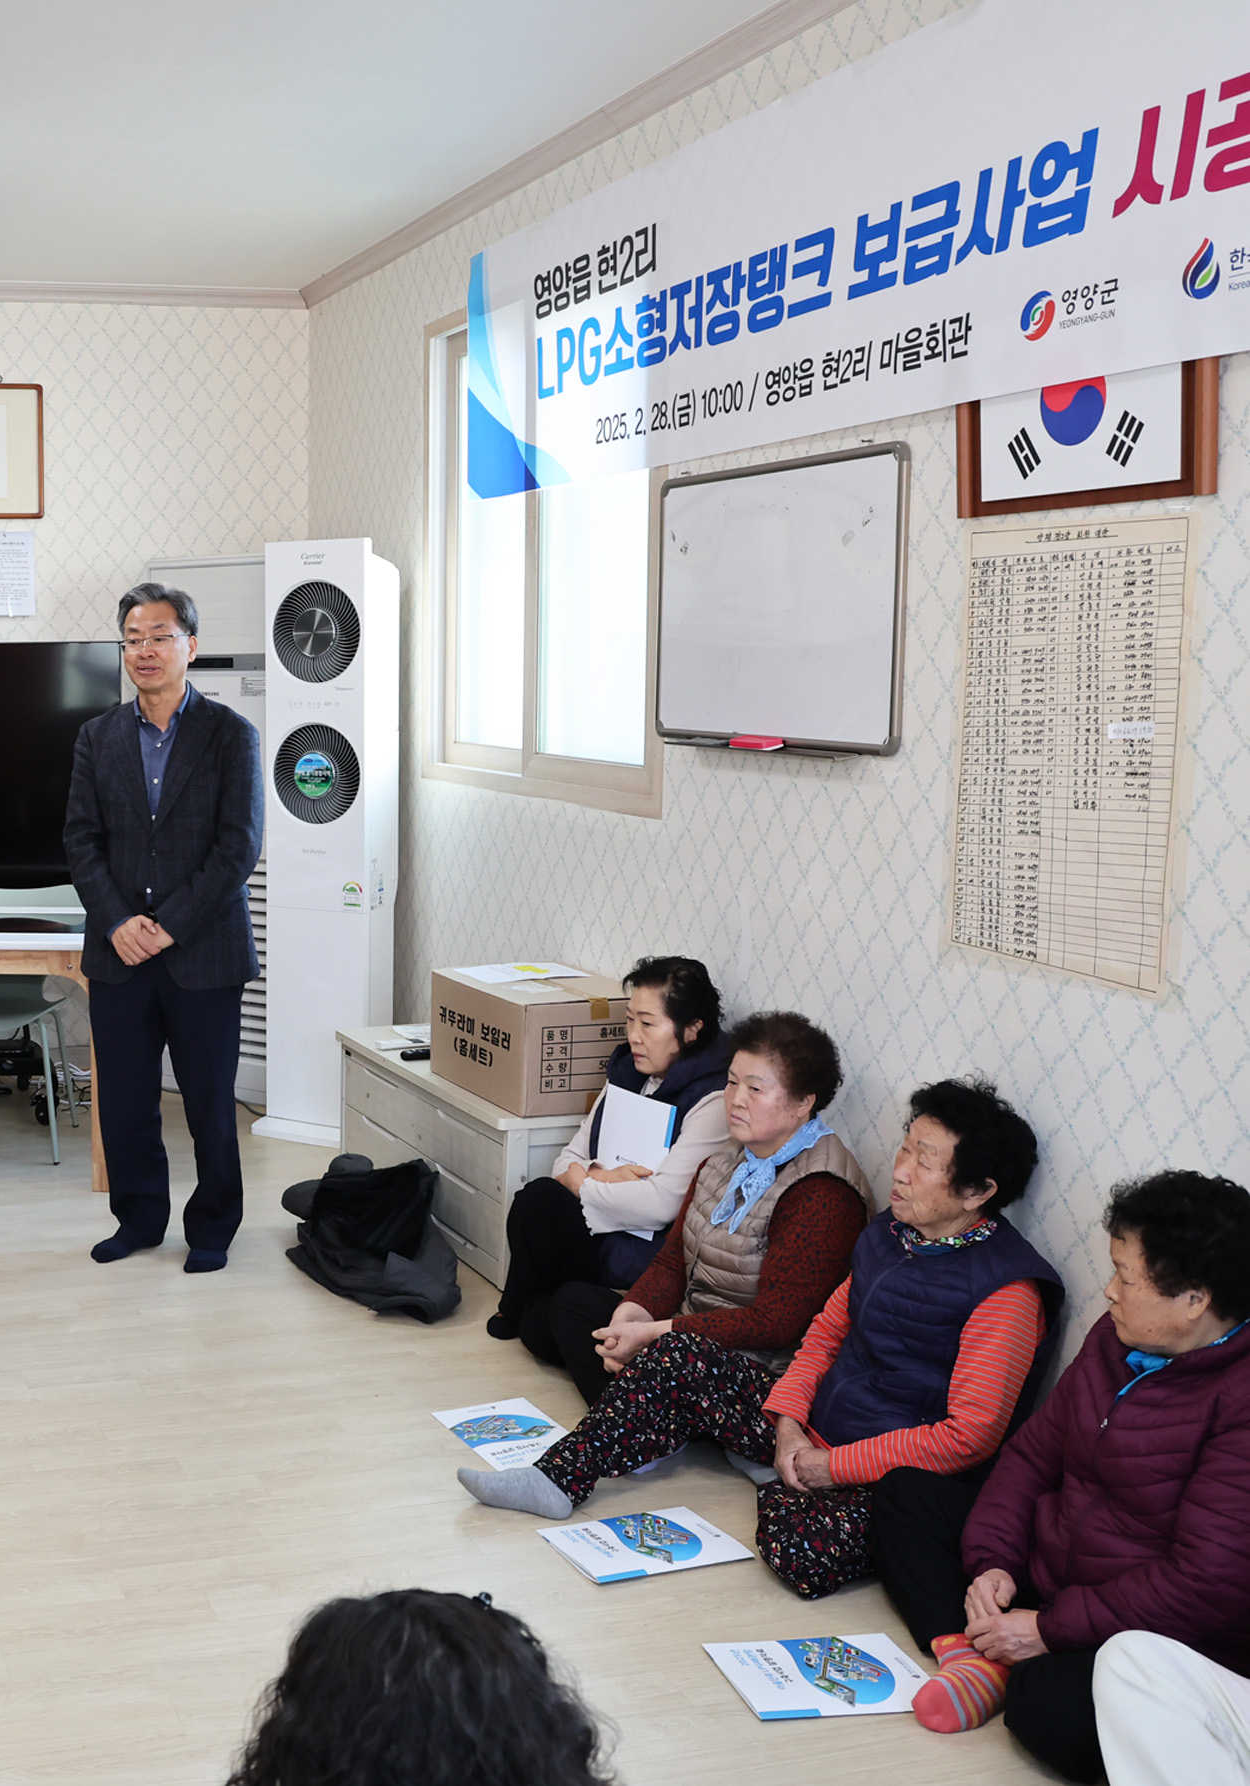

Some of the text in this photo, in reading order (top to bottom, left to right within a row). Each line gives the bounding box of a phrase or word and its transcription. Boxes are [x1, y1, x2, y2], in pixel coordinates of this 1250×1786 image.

[534, 222, 657, 320] 영양읍 현2리
[536, 226, 835, 400] LPG소형저장탱크
[847, 126, 1100, 301] 보급사업
[1061, 277, 1120, 316] 영양군
[1058, 308, 1116, 330] YEONGYANG-GUN
[595, 412, 630, 445] 2025.
[651, 388, 697, 432] 28.(금)
[701, 380, 744, 420] 10:00
[765, 357, 815, 407] 영양읍
[822, 340, 873, 392] 현2리
[879, 312, 972, 375] 마을회관
[300, 552, 326, 561] Carrier
[438, 1005, 511, 1052] 귀뚜라미 보일러
[453, 1036, 494, 1068] (홈세트)
